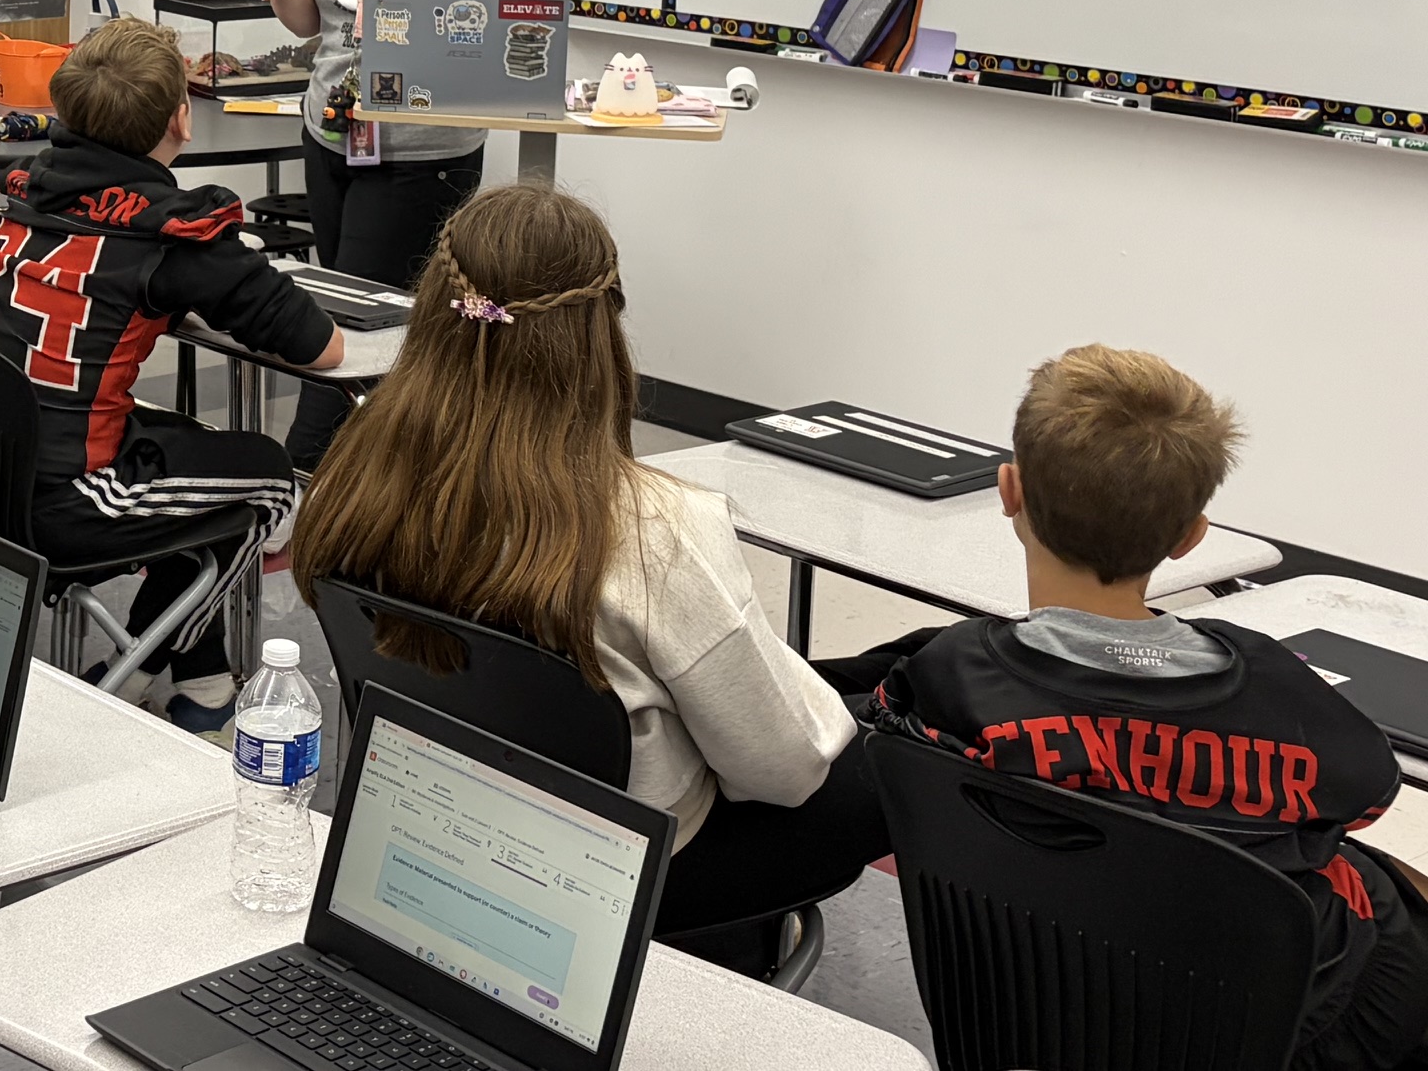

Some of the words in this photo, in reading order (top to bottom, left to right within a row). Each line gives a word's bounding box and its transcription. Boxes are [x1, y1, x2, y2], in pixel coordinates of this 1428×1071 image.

[503, 4, 560, 15] ELEVATE
[449, 36, 482, 44] SPACE
[1105, 645, 1172, 660] CHALKTALK
[1118, 656, 1164, 667] SPORTS
